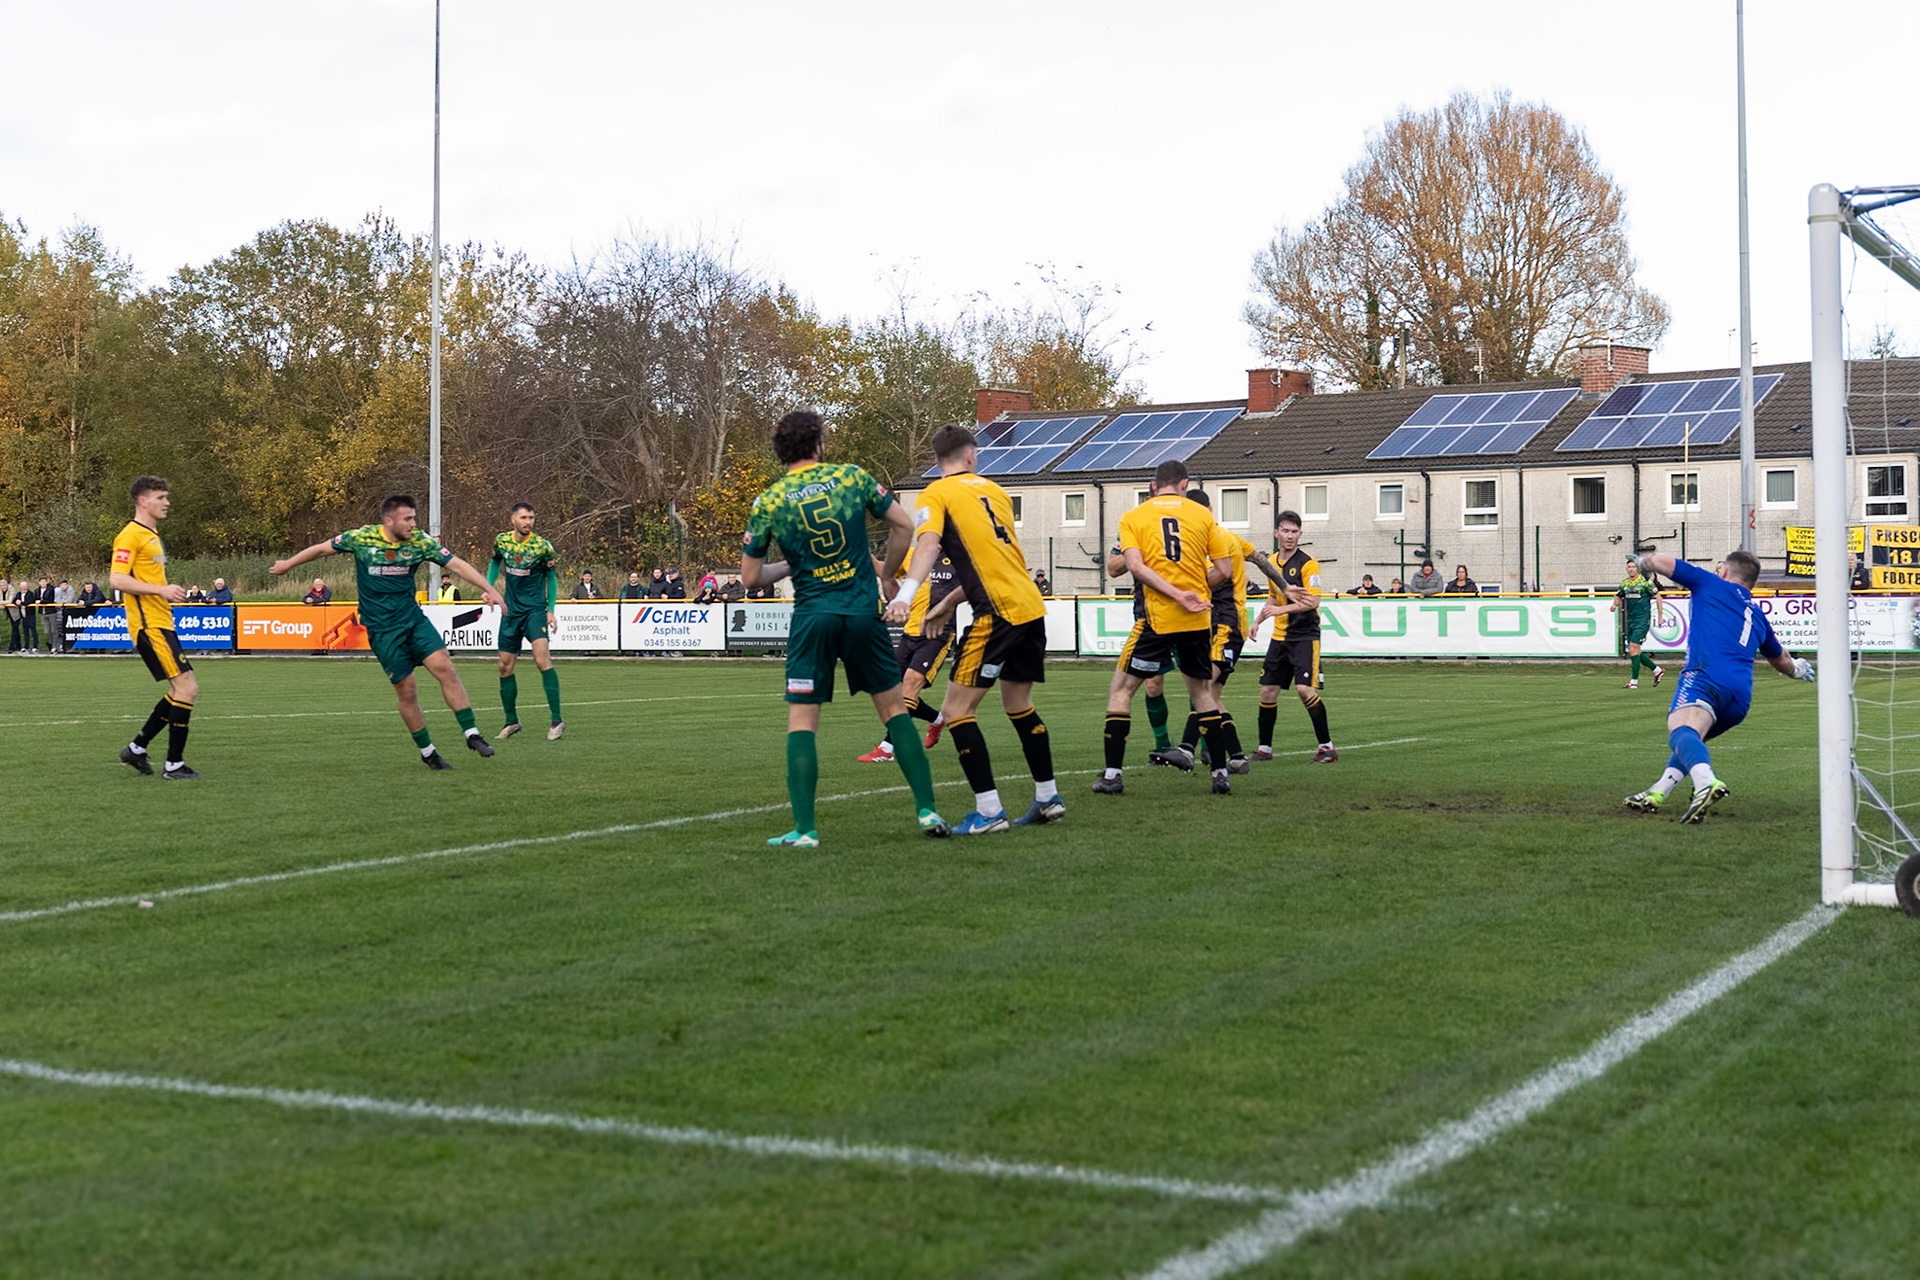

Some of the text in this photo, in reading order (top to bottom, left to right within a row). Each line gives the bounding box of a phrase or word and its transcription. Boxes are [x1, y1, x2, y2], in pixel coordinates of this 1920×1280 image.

[799, 496, 846, 559] 5
[1161, 517, 1181, 562] 6
[1876, 529, 1920, 543] PRESC
[1888, 549, 1913, 566] 18
[178, 616, 201, 629] 426
[202, 616, 231, 629] 5310
[651, 609, 710, 624] CEMEX
[754, 612, 787, 620] DEBBIE
[652, 626, 691, 636] Asphalt
[755, 622, 779, 632] 0151
[1738, 606, 1754, 648] 1
[442, 629, 492, 647] CARLING
[561, 634, 577, 642] 0151
[644, 638, 702, 647] 0345 155 6367
